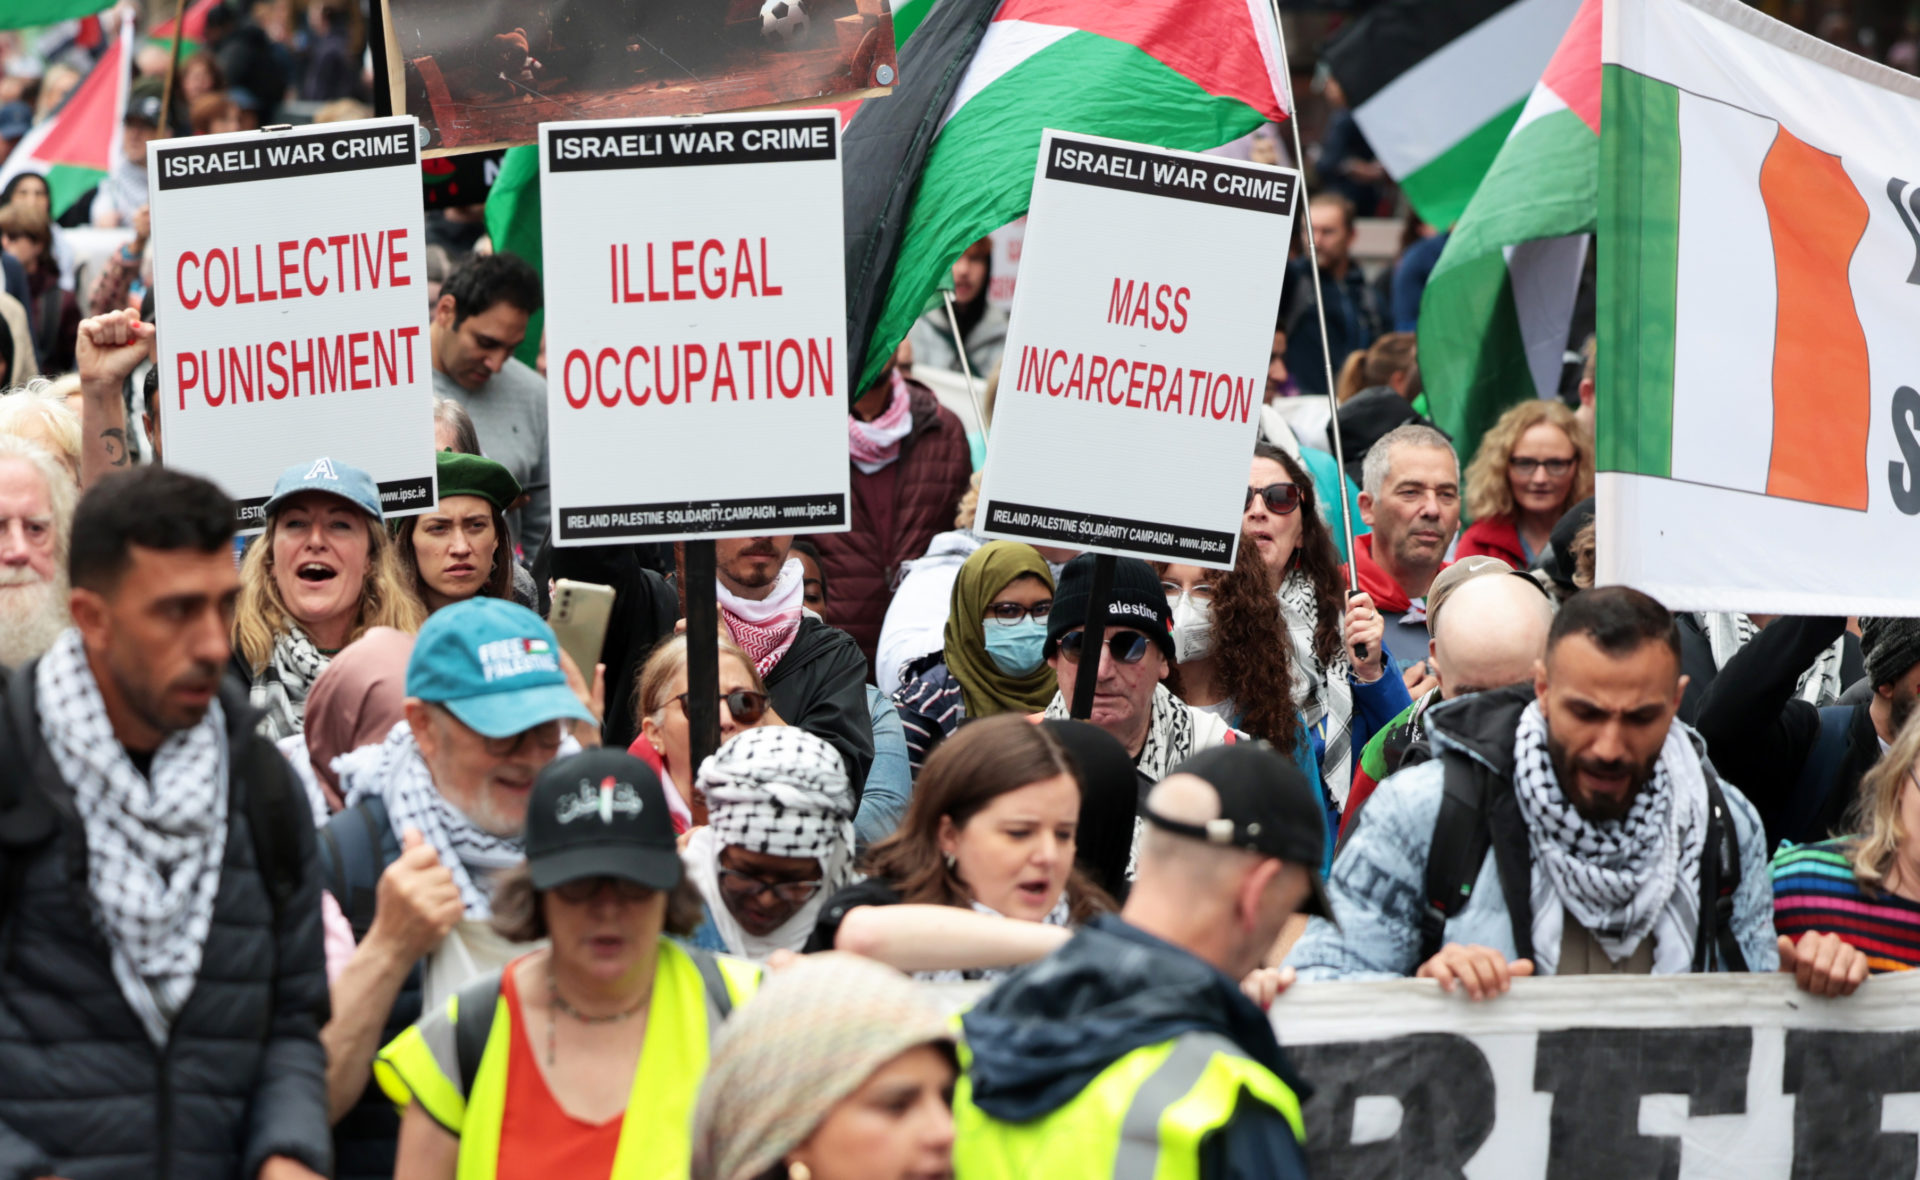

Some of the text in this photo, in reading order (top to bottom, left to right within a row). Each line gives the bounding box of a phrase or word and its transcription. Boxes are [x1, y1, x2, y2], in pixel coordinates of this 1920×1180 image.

[164, 133, 409, 178] ISRAELI WAR CRIME
[556, 126, 829, 160] ISRAELI WAR CRIME
[1054, 147, 1288, 203] ISRAELI WAR CRIME
[176, 228, 411, 311] COLLECTIVE
[610, 237, 783, 303] ILLEGAL
[1107, 277, 1191, 334] MASS
[176, 326, 420, 411] PUNISHMENT
[563, 337, 833, 409] OCCUPATION
[1016, 345, 1254, 423] INCARCERATION
[304, 457, 338, 480] A
[380, 486, 426, 503] www.ipsc.ie
[567, 514, 609, 529] IRELAND
[611, 511, 664, 526] PALESTINE
[666, 508, 724, 524] SOLIDARITY
[725, 506, 776, 520] CAMPAIGN
[783, 502, 837, 519] www.ipsc.ie
[993, 509, 1030, 526] IRELAND
[1031, 515, 1078, 532] PALESTINE
[1078, 521, 1128, 539] SOLIDARITY
[1129, 528, 1174, 546] CAMPAIGN
[1180, 537, 1226, 553] www.ipsc.ie
[1109, 600, 1158, 621] alestine
